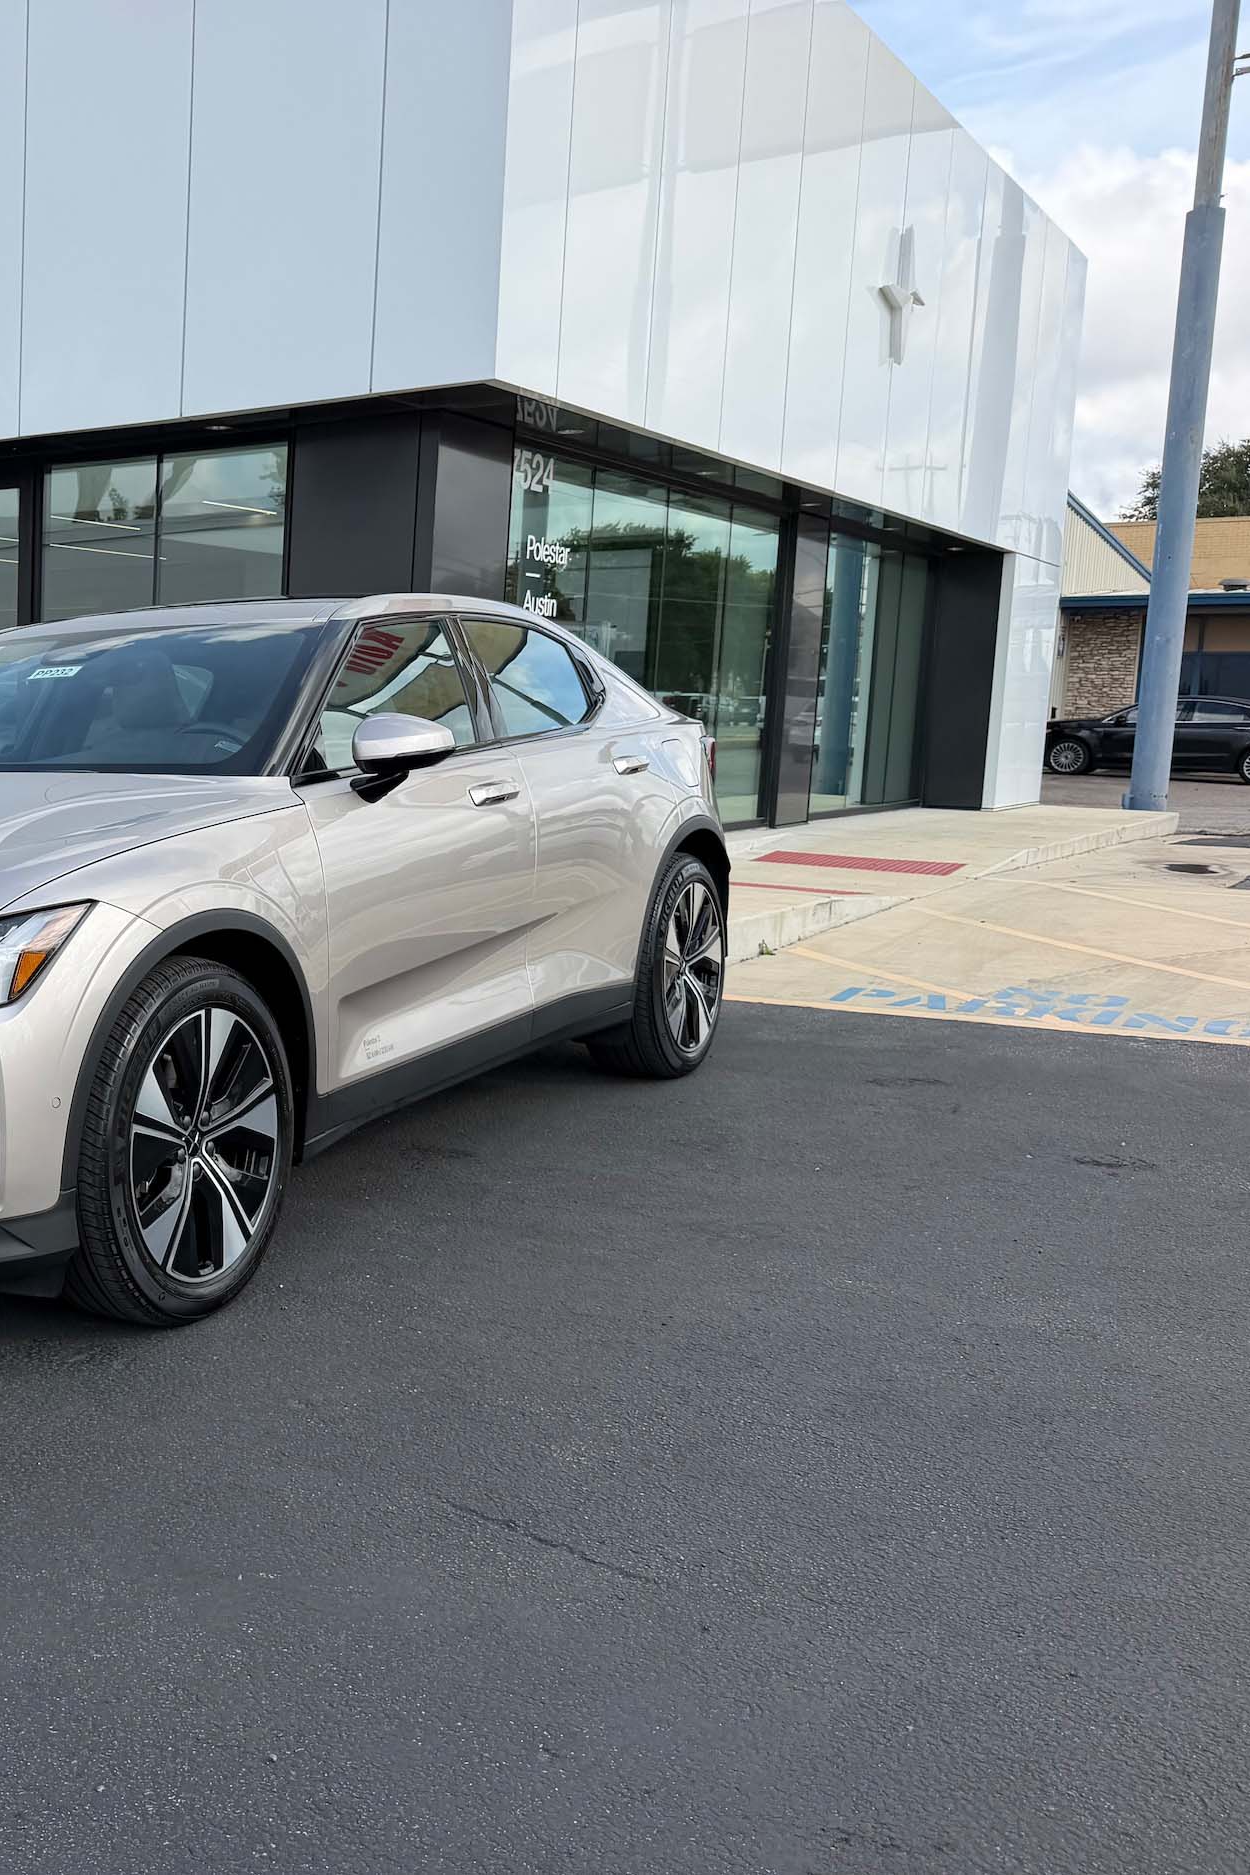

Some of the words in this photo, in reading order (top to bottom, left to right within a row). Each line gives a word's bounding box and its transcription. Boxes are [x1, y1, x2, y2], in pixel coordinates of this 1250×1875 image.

[514, 448, 555, 495] 7524
[526, 534, 570, 564] Polestar
[523, 589, 557, 617] Austin
